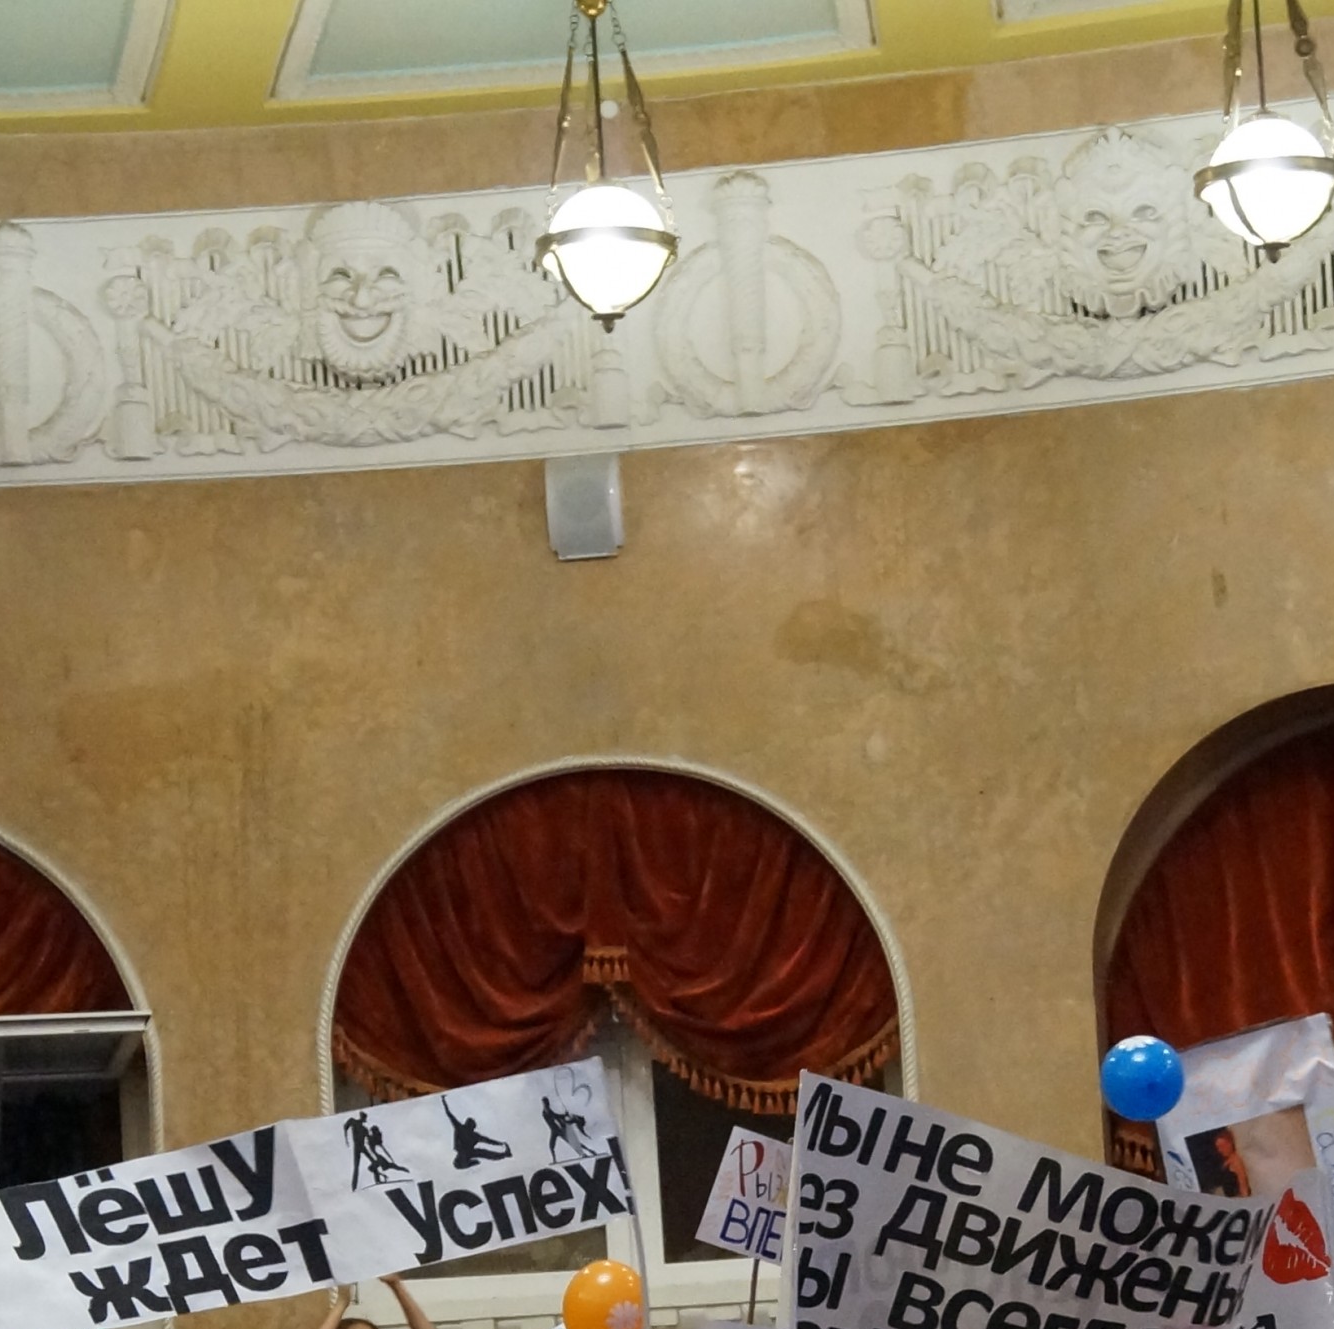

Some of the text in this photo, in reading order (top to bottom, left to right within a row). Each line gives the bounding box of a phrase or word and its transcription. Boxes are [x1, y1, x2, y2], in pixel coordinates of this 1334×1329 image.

[882, 1114, 994, 1197] не
[67, 1135, 635, 1325] ждет успех!
[719, 1198, 786, 1262] ВПЕ
